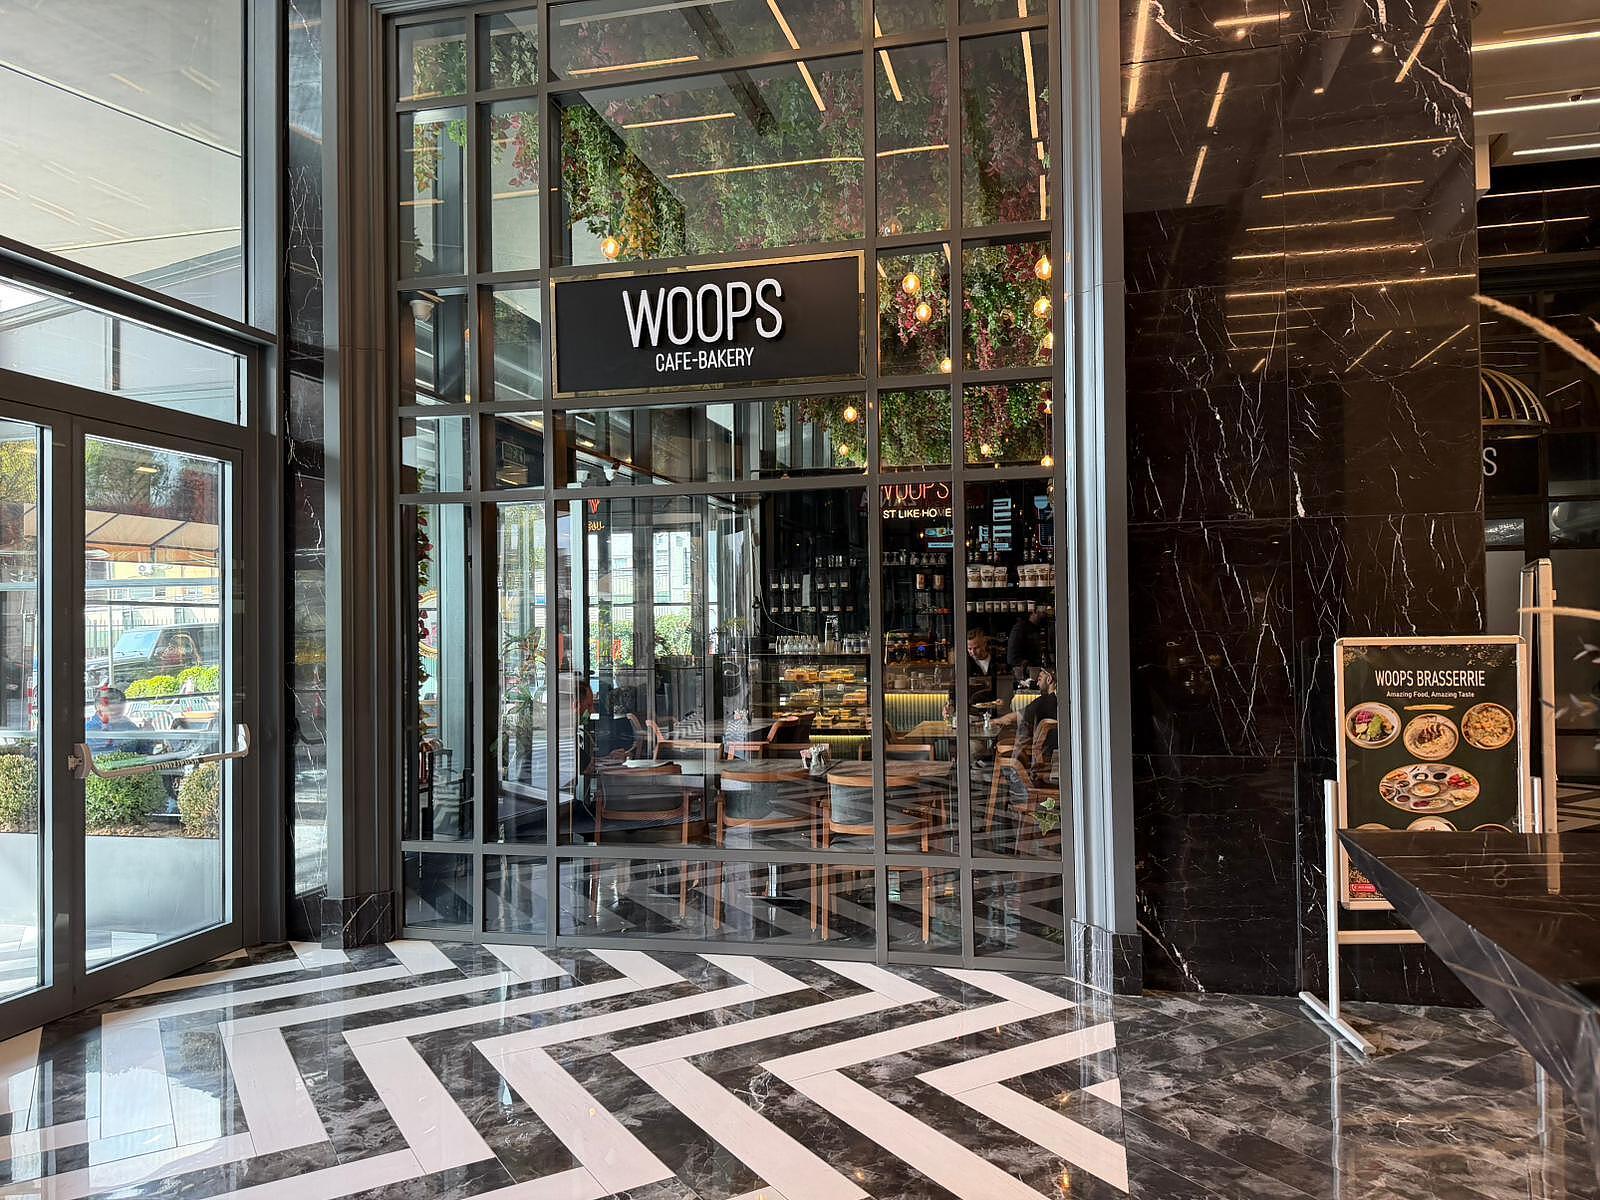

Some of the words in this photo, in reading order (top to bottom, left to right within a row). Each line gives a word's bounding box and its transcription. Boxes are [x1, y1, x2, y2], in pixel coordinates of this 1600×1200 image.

[622, 278, 783, 348] WOOPS
[655, 347, 754, 372] CAFE-BAKERY
[898, 508, 920, 519] LIKE
[1375, 670, 1414, 687] WOOPS
[1416, 670, 1486, 687] BRASSERRIE
